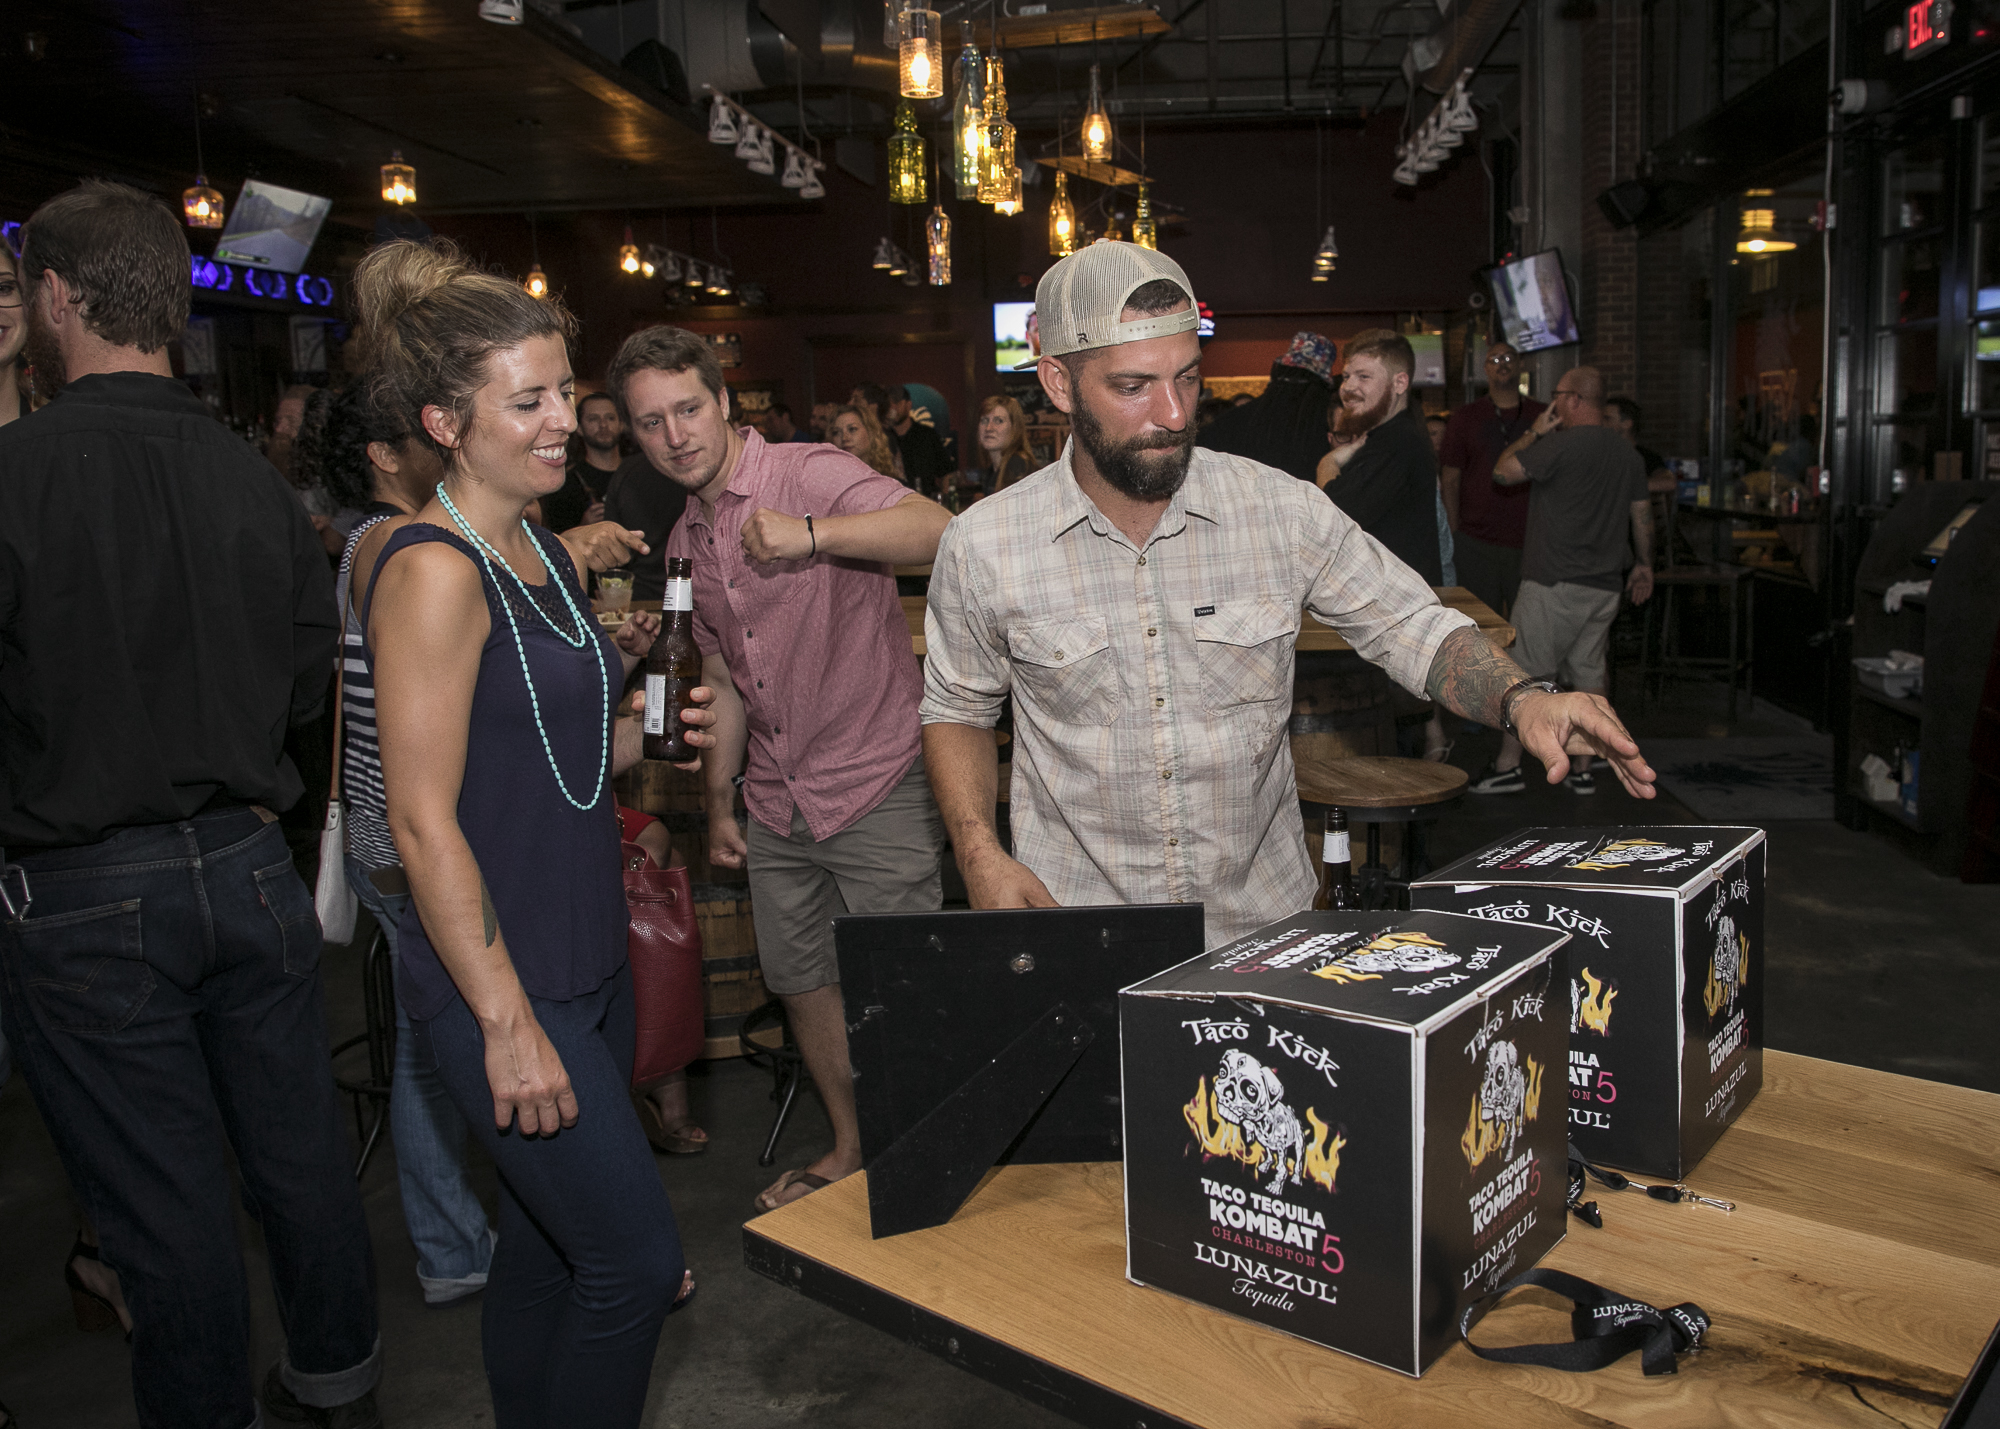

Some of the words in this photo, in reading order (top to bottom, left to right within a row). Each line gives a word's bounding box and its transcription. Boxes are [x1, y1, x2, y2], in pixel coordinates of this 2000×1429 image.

[1909, 0, 1934, 50] EX
[1730, 879, 1750, 904] Kick
[1467, 900, 1530, 920] Taco
[1546, 904, 1611, 949] Kick
[1466, 945, 1502, 970] Taco
[1392, 972, 1470, 995] Kick
[1181, 1016, 1250, 1045] Taco
[1267, 1025, 1340, 1087] Kick
[1464, 1010, 1504, 1064] Taco
[1511, 993, 1544, 1022] Kick
[1708, 1031, 1723, 1055] TACO
[1710, 1025, 1742, 1073] KOMBAT
[1743, 1019, 1750, 1050] 5
[1596, 1070, 1617, 1104] 5
[1705, 1061, 1747, 1118] LUNAZUL
[1469, 1181, 1495, 1213] TACO
[1496, 1148, 1533, 1189] TEQUILA
[1473, 1167, 1529, 1236] KOMBAT
[1530, 1159, 1541, 1197] 5
[1201, 1177, 1247, 1205] TACO
[1250, 1192, 1326, 1230] TEQUILA
[1210, 1198, 1318, 1251] KOMBAT
[1193, 1241, 1337, 1304] LUNAZUL
[1212, 1226, 1316, 1267] CHARLESTON
[1321, 1233, 1345, 1274] 5
[1463, 1210, 1537, 1291] LUNAZUL
[1232, 1278, 1296, 1312] Tequila
[1593, 1303, 1663, 1320] LUNAZUL
